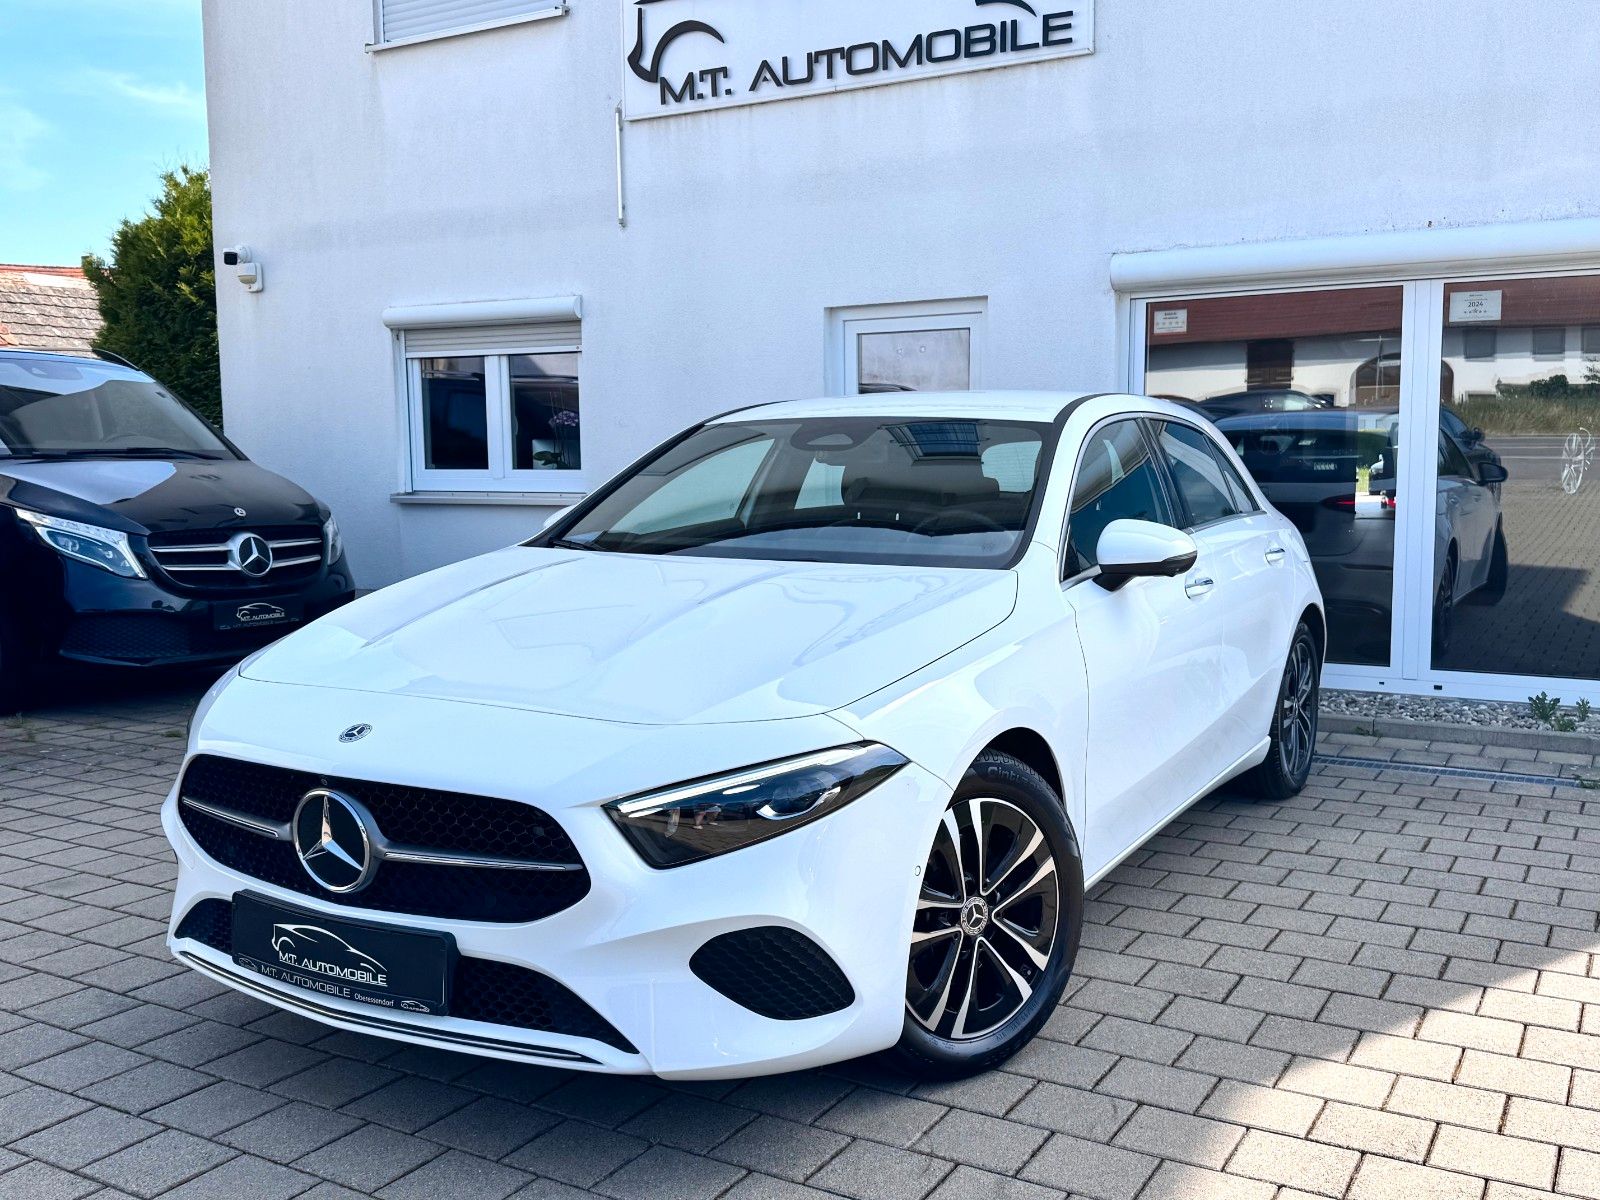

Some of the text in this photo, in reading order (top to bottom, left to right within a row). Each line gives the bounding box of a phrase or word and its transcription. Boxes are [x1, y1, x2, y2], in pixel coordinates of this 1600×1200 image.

[659, 11, 1074, 105] M.T. AUTOMOBILE
[261, 964, 278, 978] M.T.
[281, 971, 350, 998] AUTOMOBILE
[279, 950, 387, 984] M.T. AUTOMOBILE
